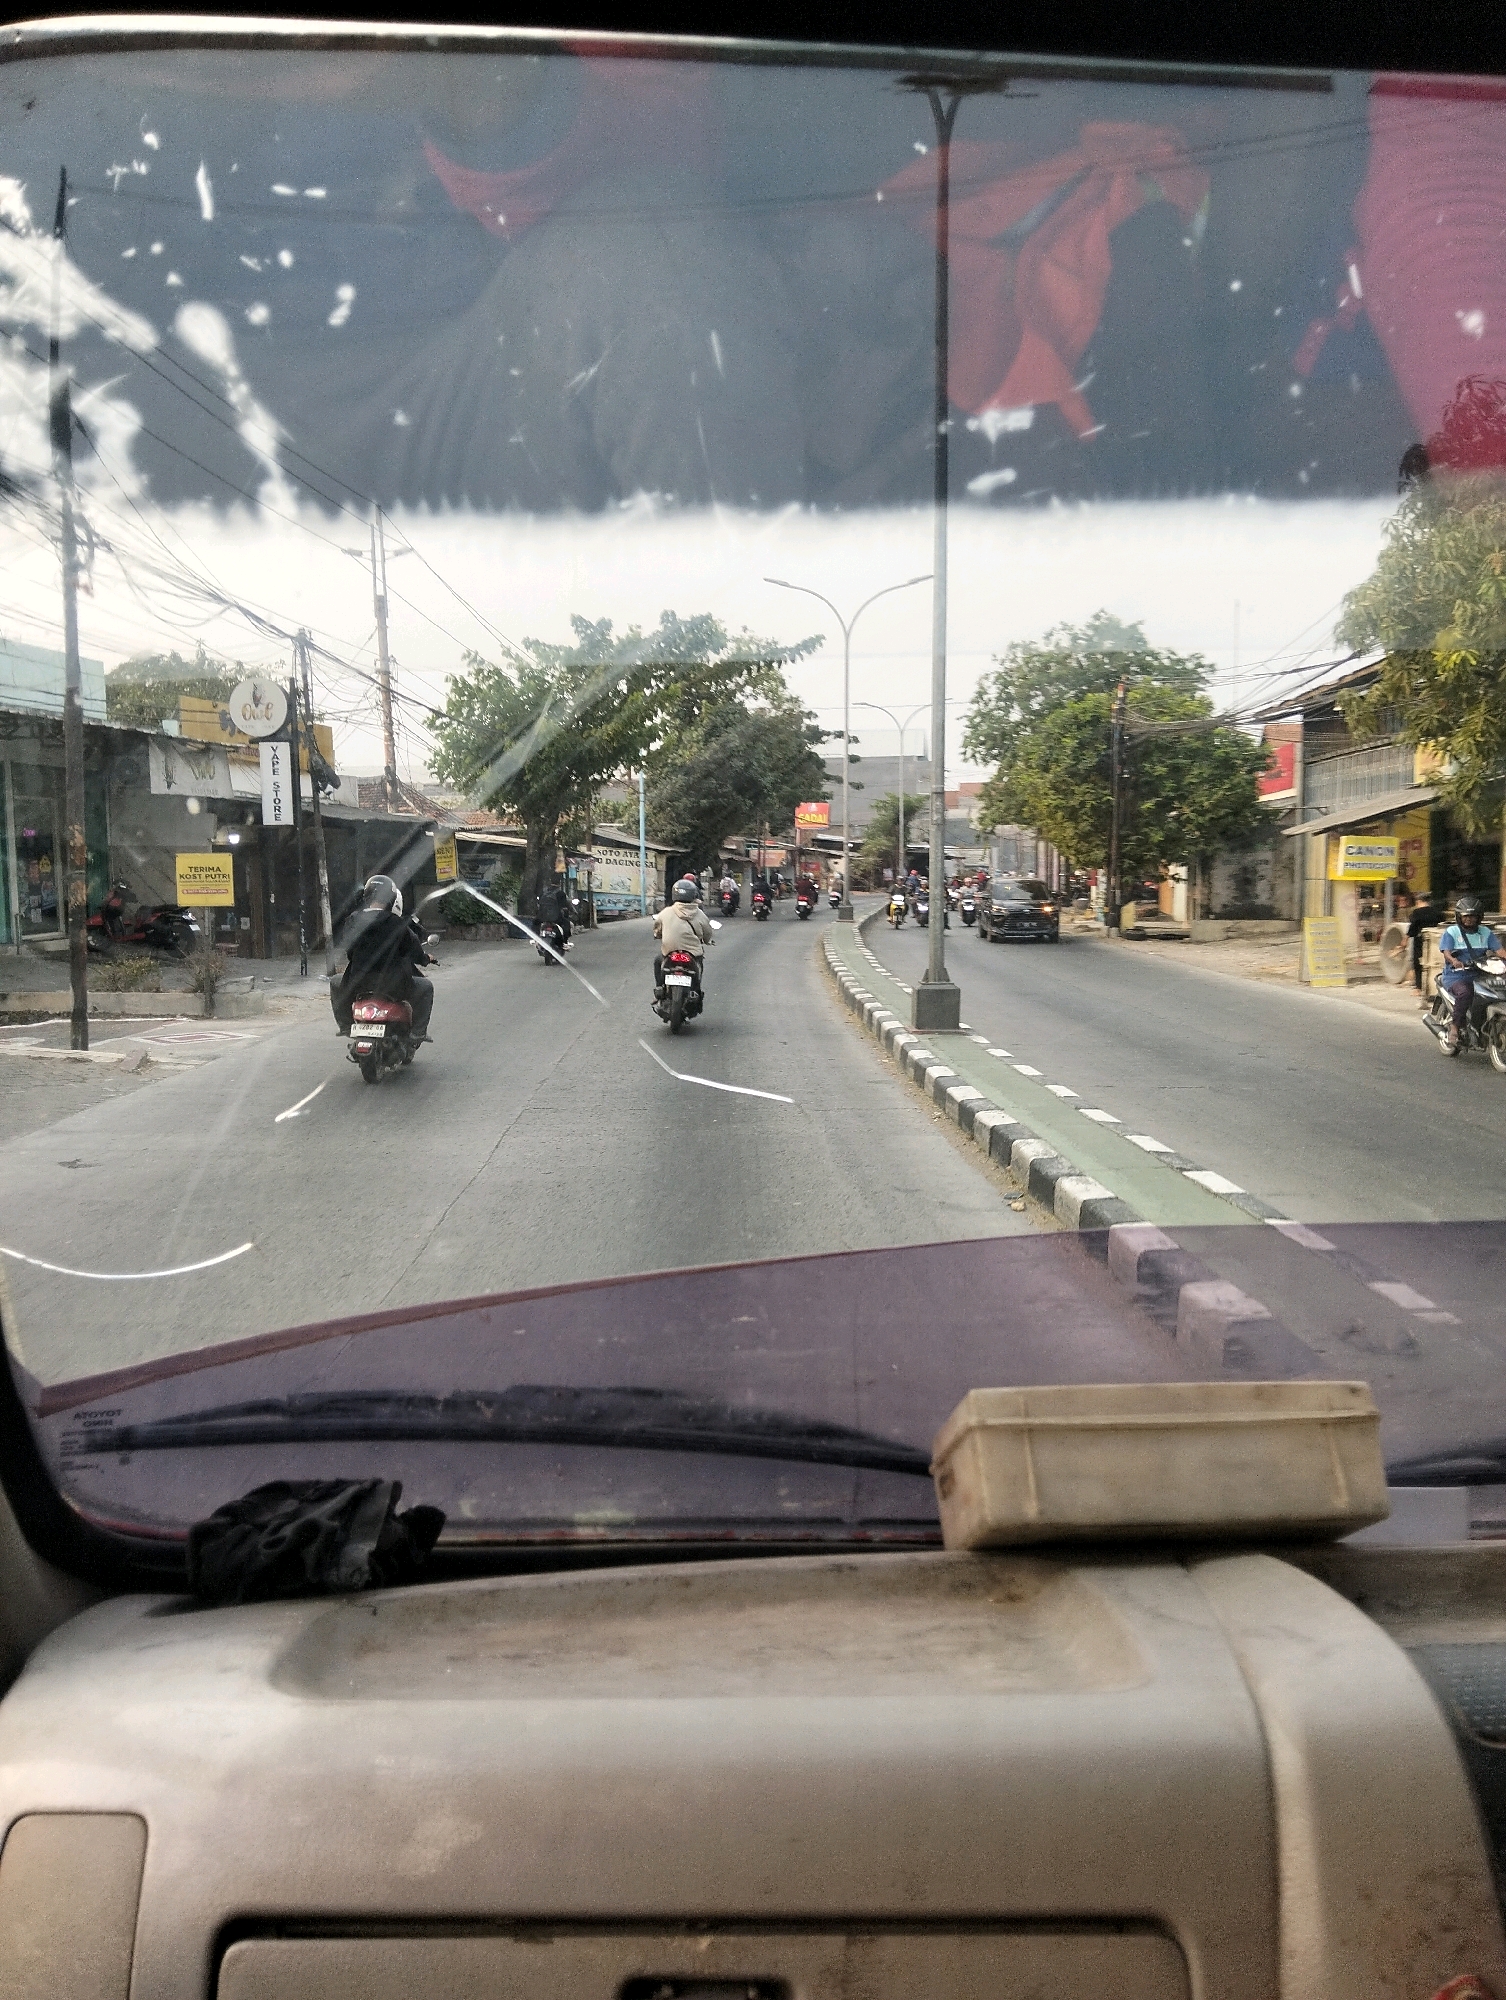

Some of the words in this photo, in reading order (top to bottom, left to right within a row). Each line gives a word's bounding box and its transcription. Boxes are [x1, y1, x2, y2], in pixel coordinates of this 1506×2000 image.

[270, 745, 280, 776] VAPE
[272, 781, 282, 822] STORE
[597, 849, 620, 857] SOTO
